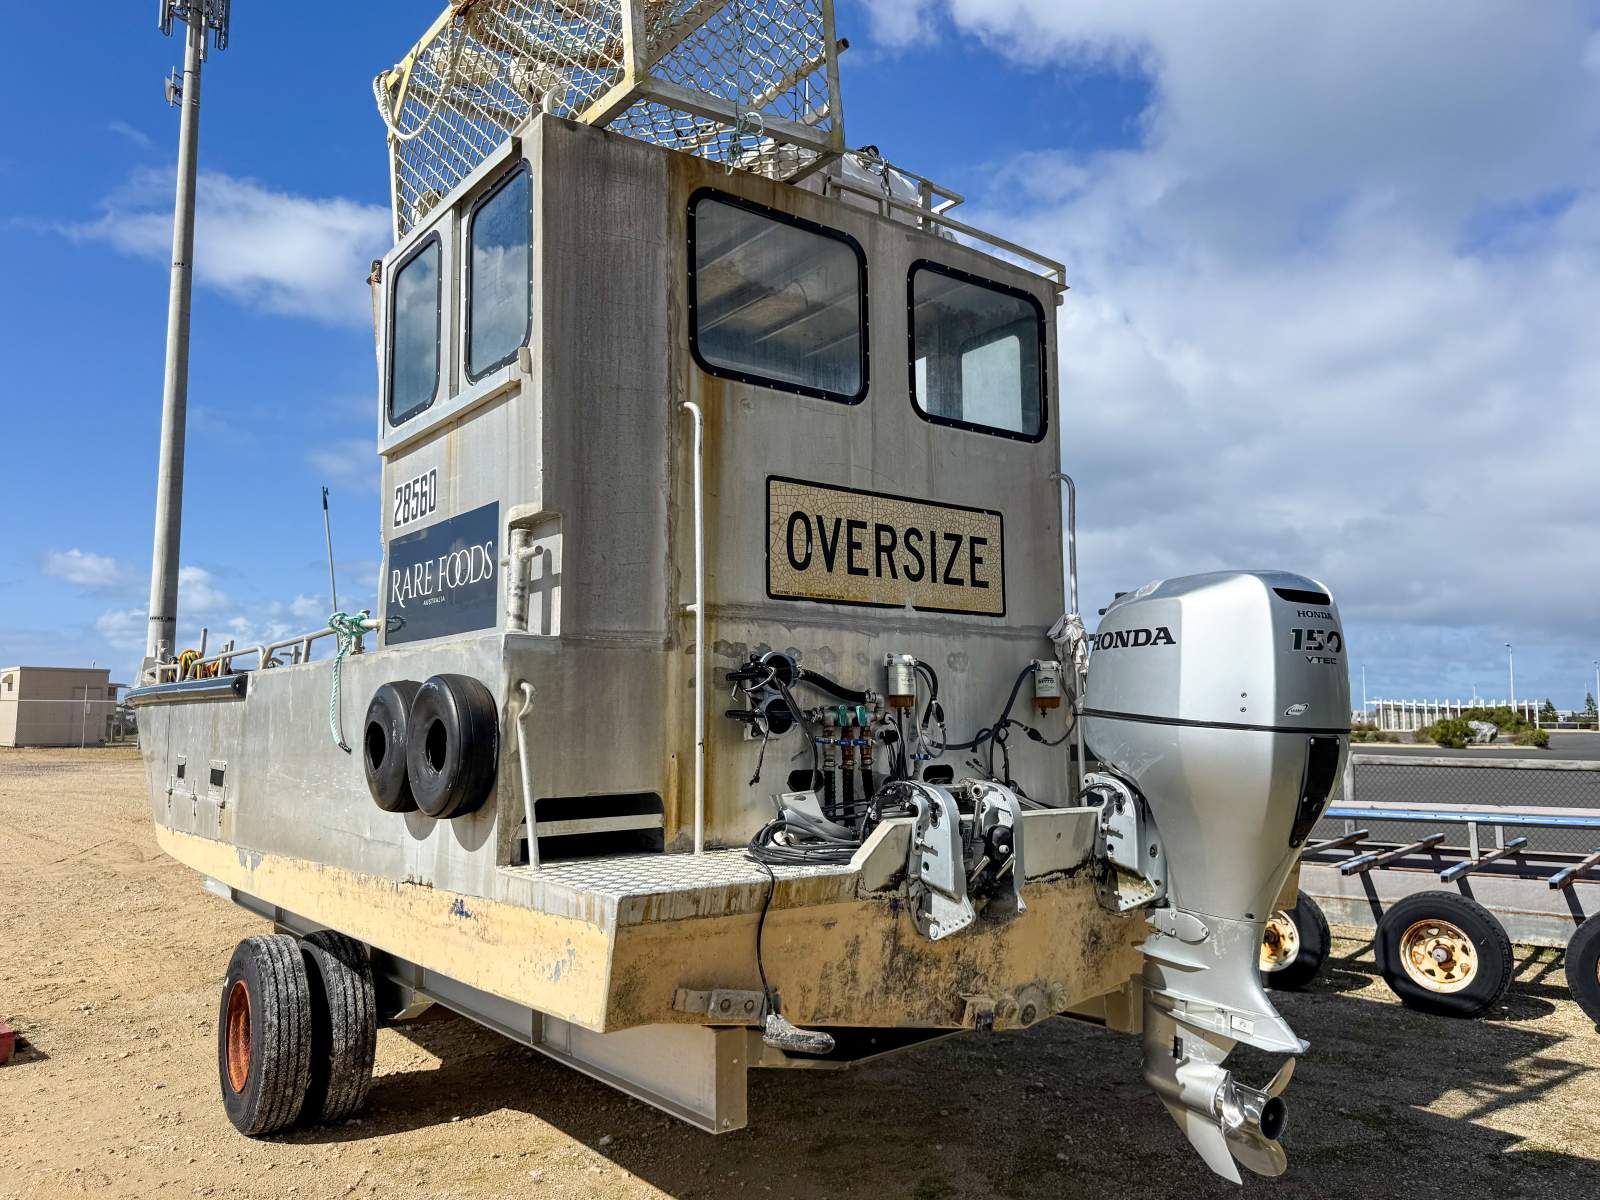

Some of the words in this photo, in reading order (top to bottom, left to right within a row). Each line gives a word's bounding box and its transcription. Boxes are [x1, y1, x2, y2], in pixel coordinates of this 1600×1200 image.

[393, 468, 437, 528] 28560
[786, 510, 990, 589] OVERSIZE
[391, 560, 434, 608] RARE
[438, 541, 494, 592] FOODS
[1092, 626, 1177, 652] HONDA
[1290, 628, 1342, 653] 150
[1305, 656, 1337, 665] VTEC
